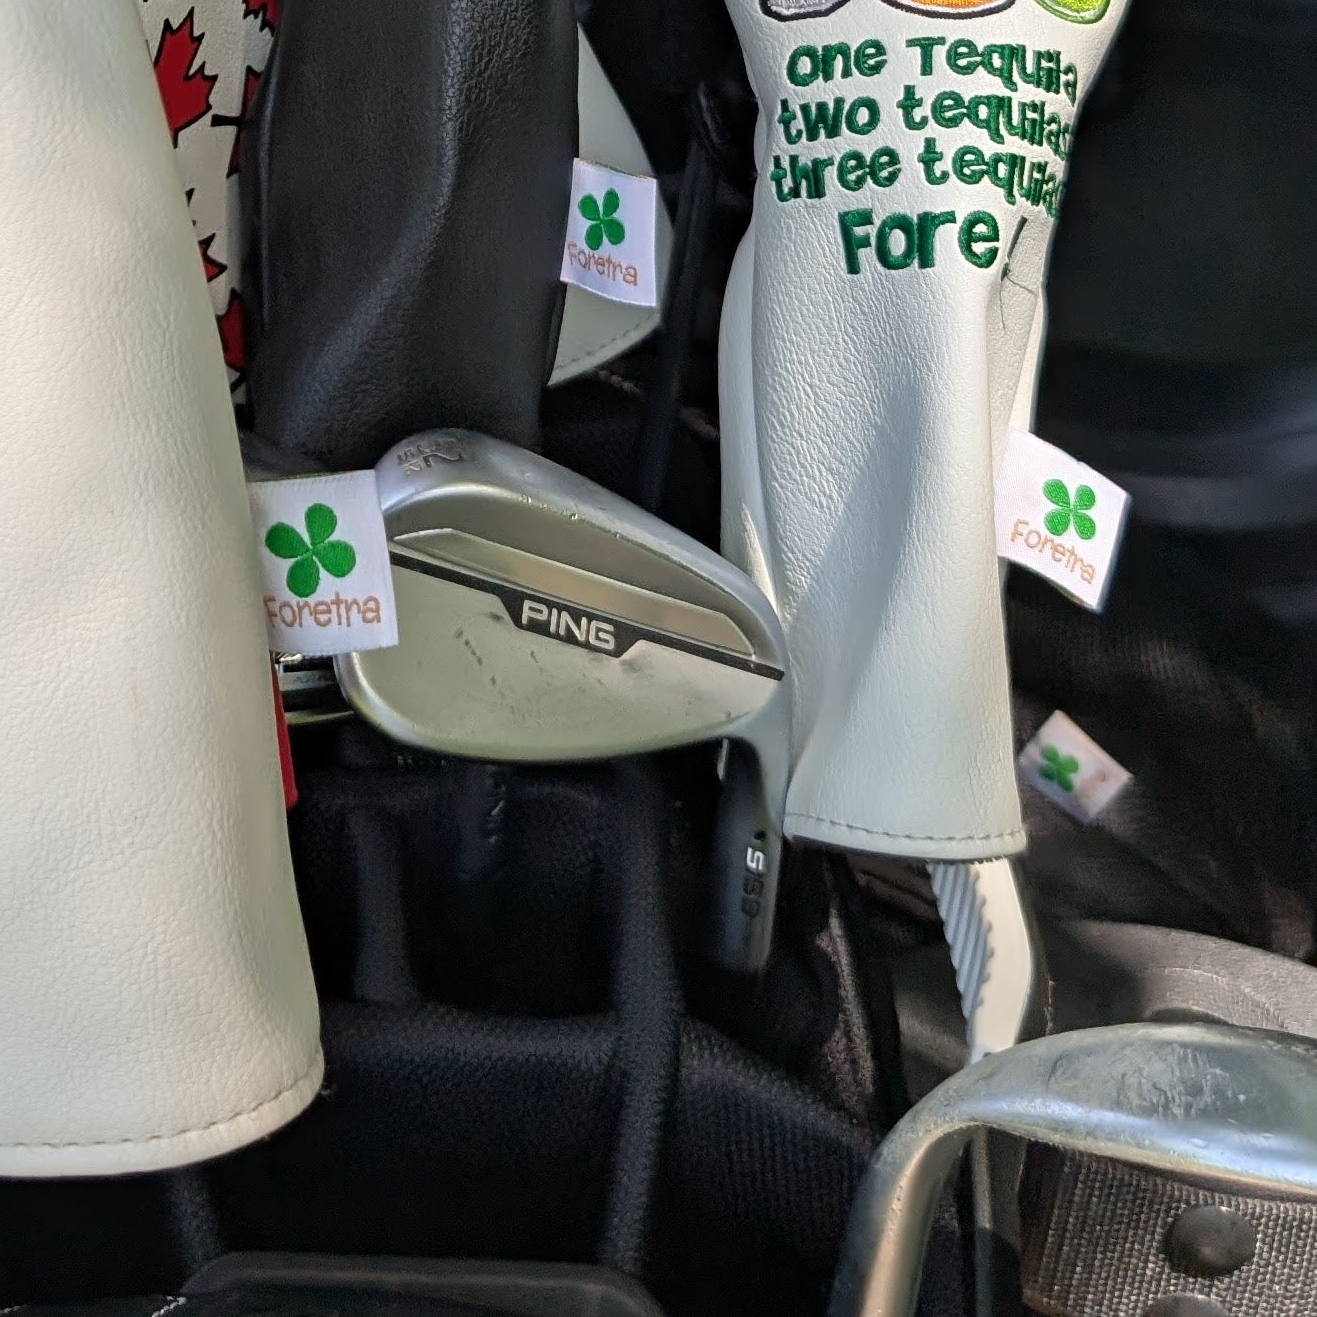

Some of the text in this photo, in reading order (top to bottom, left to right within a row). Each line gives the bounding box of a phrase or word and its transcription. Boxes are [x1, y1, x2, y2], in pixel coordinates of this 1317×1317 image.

[786, 38, 887, 87] one
[777, 96, 881, 145] two
[770, 146, 902, 202] three
[567, 243, 639, 286] Foretra
[1011, 519, 1096, 584] Foretra
[263, 592, 381, 628] Foretra
[521, 599, 616, 650] PING
